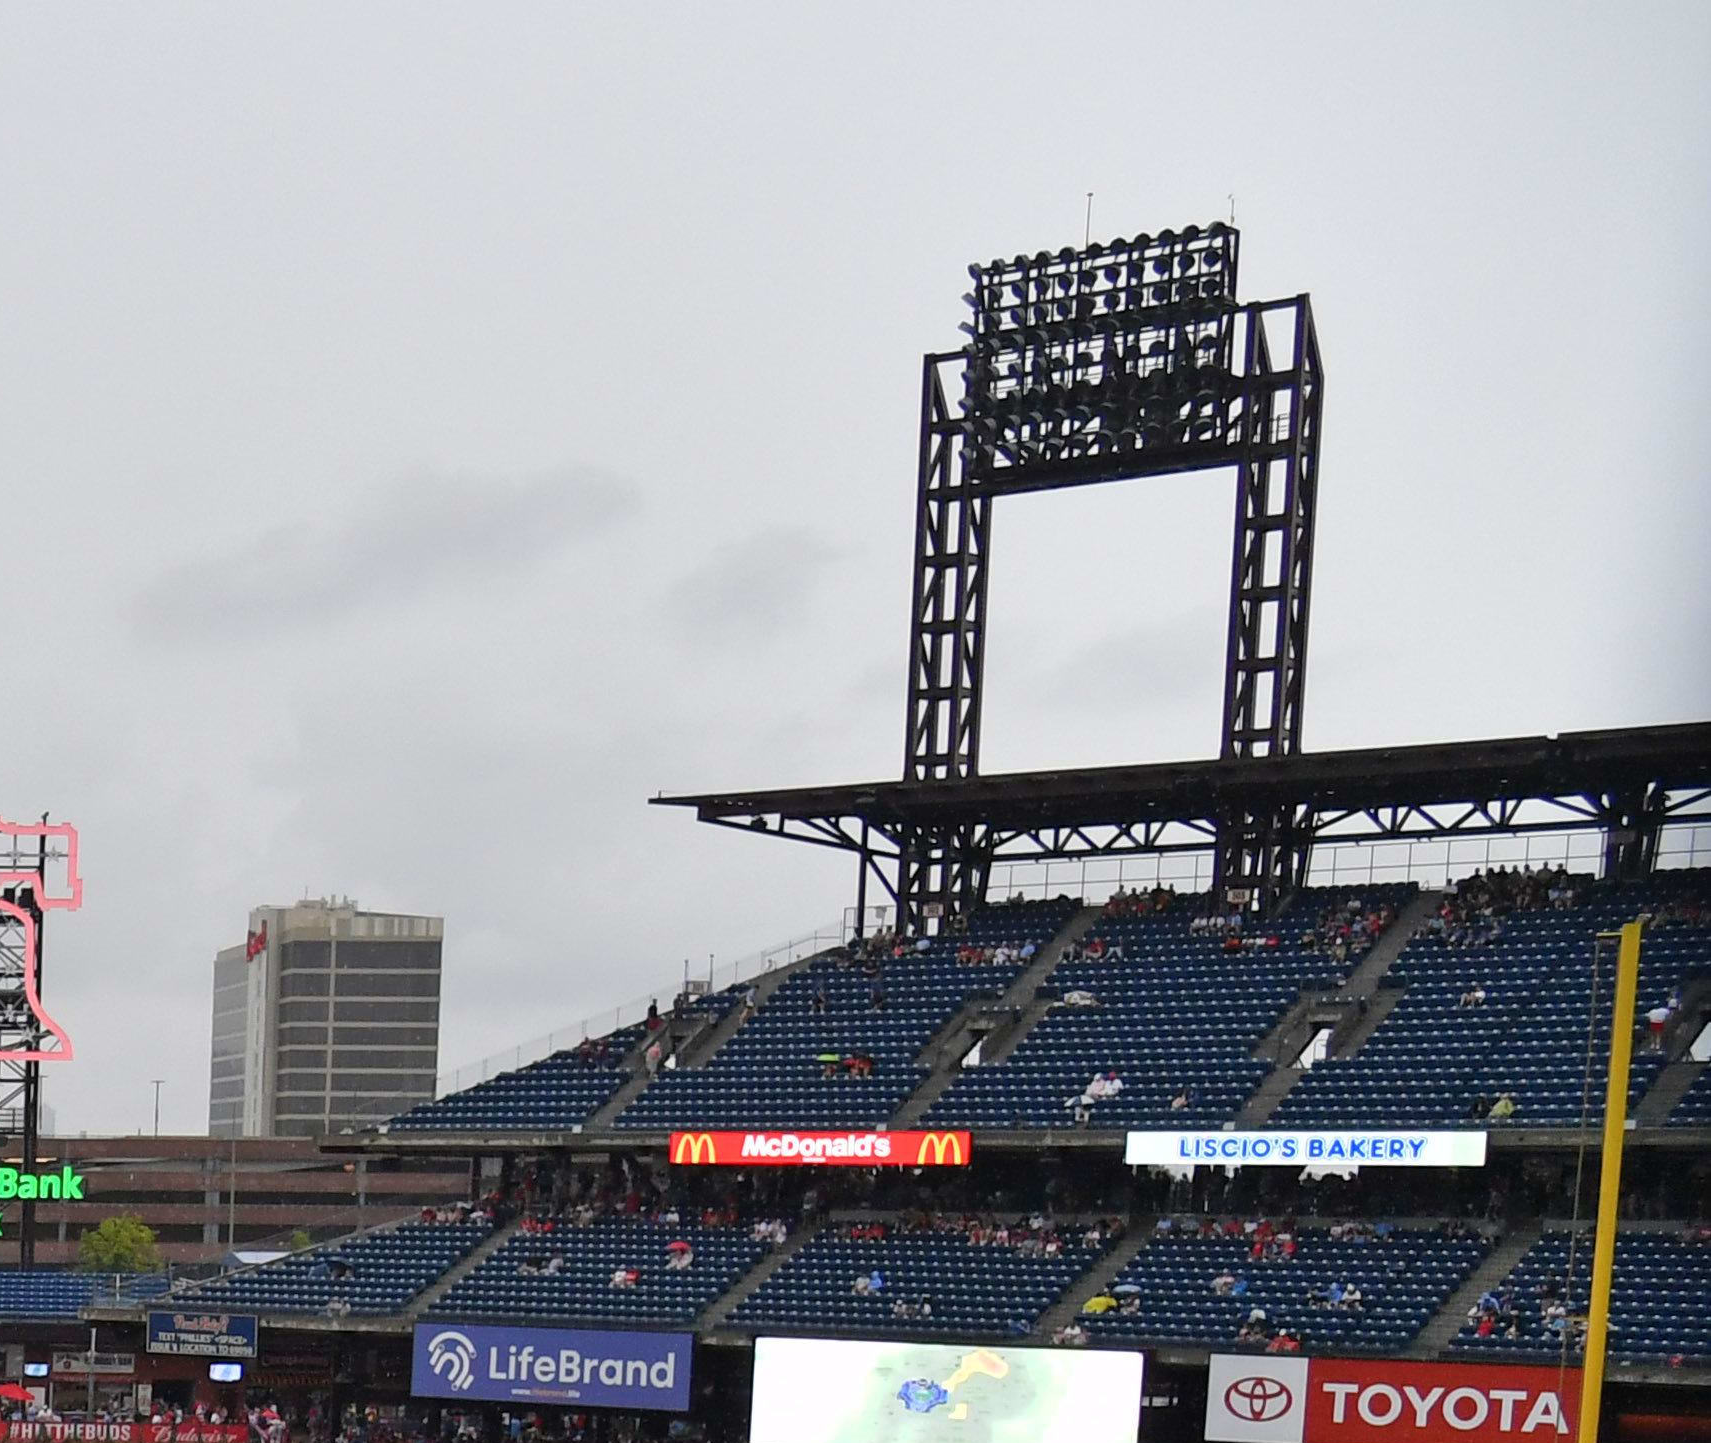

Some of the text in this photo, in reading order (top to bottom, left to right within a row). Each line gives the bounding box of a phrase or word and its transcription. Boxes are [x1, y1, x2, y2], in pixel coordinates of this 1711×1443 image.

[742, 1132, 891, 1160] McDonald's
[1178, 1136, 1427, 1159] LISCIO'S BAKERY
[489, 1345, 676, 1389] LifeBrand
[1322, 1381, 1571, 1436] TOYOTA
